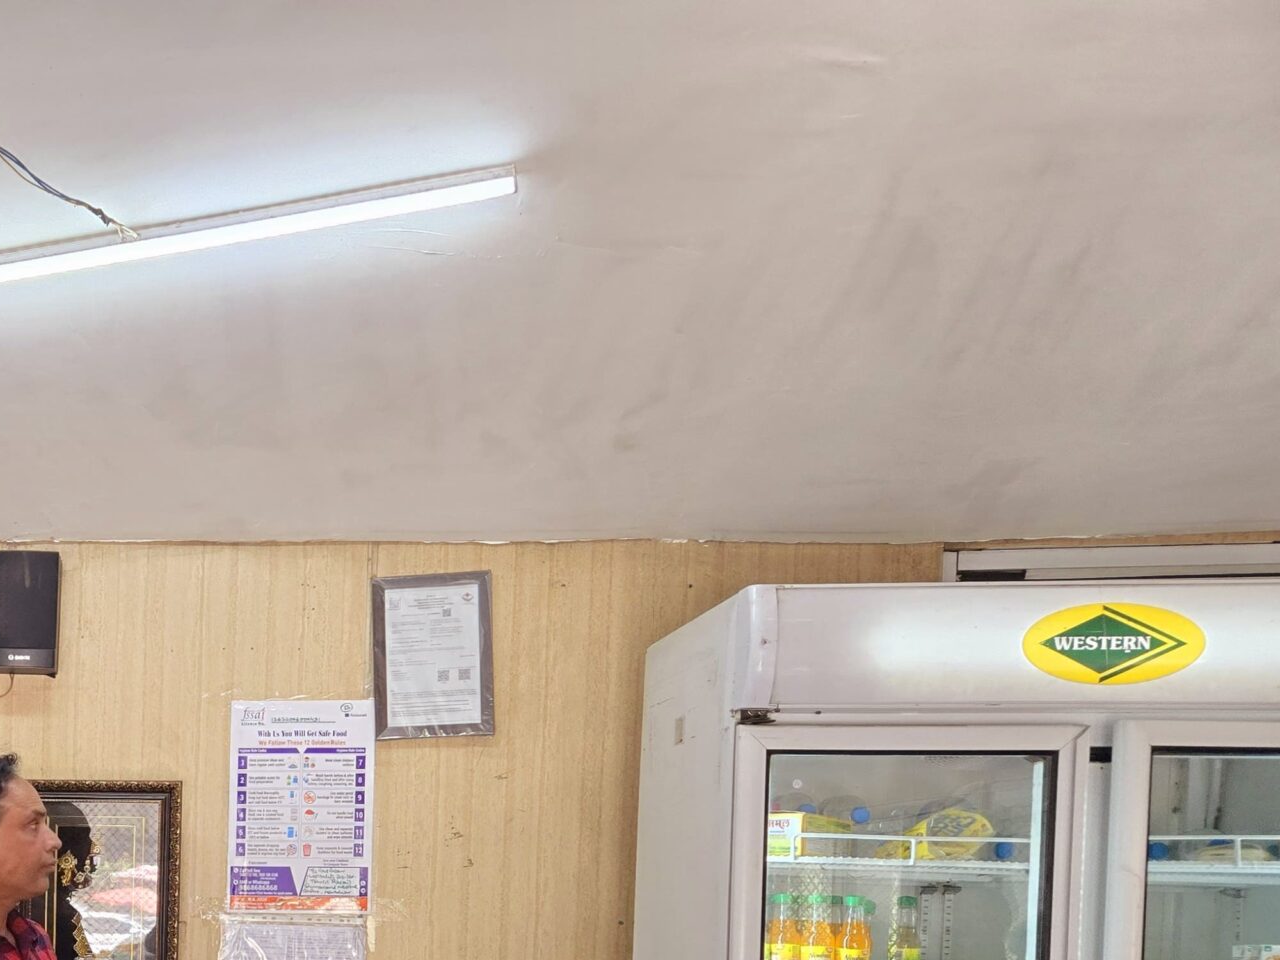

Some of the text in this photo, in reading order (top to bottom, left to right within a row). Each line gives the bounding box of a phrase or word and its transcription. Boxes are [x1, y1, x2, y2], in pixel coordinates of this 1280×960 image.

[1054, 636, 1151, 652] WESTERN
[241, 707, 266, 721] fssai
[258, 730, 271, 738] With
[281, 730, 293, 738] You
[294, 730, 306, 738] Will
[307, 730, 317, 738] Get
[318, 730, 331, 738] Safe
[332, 730, 348, 738] Food
